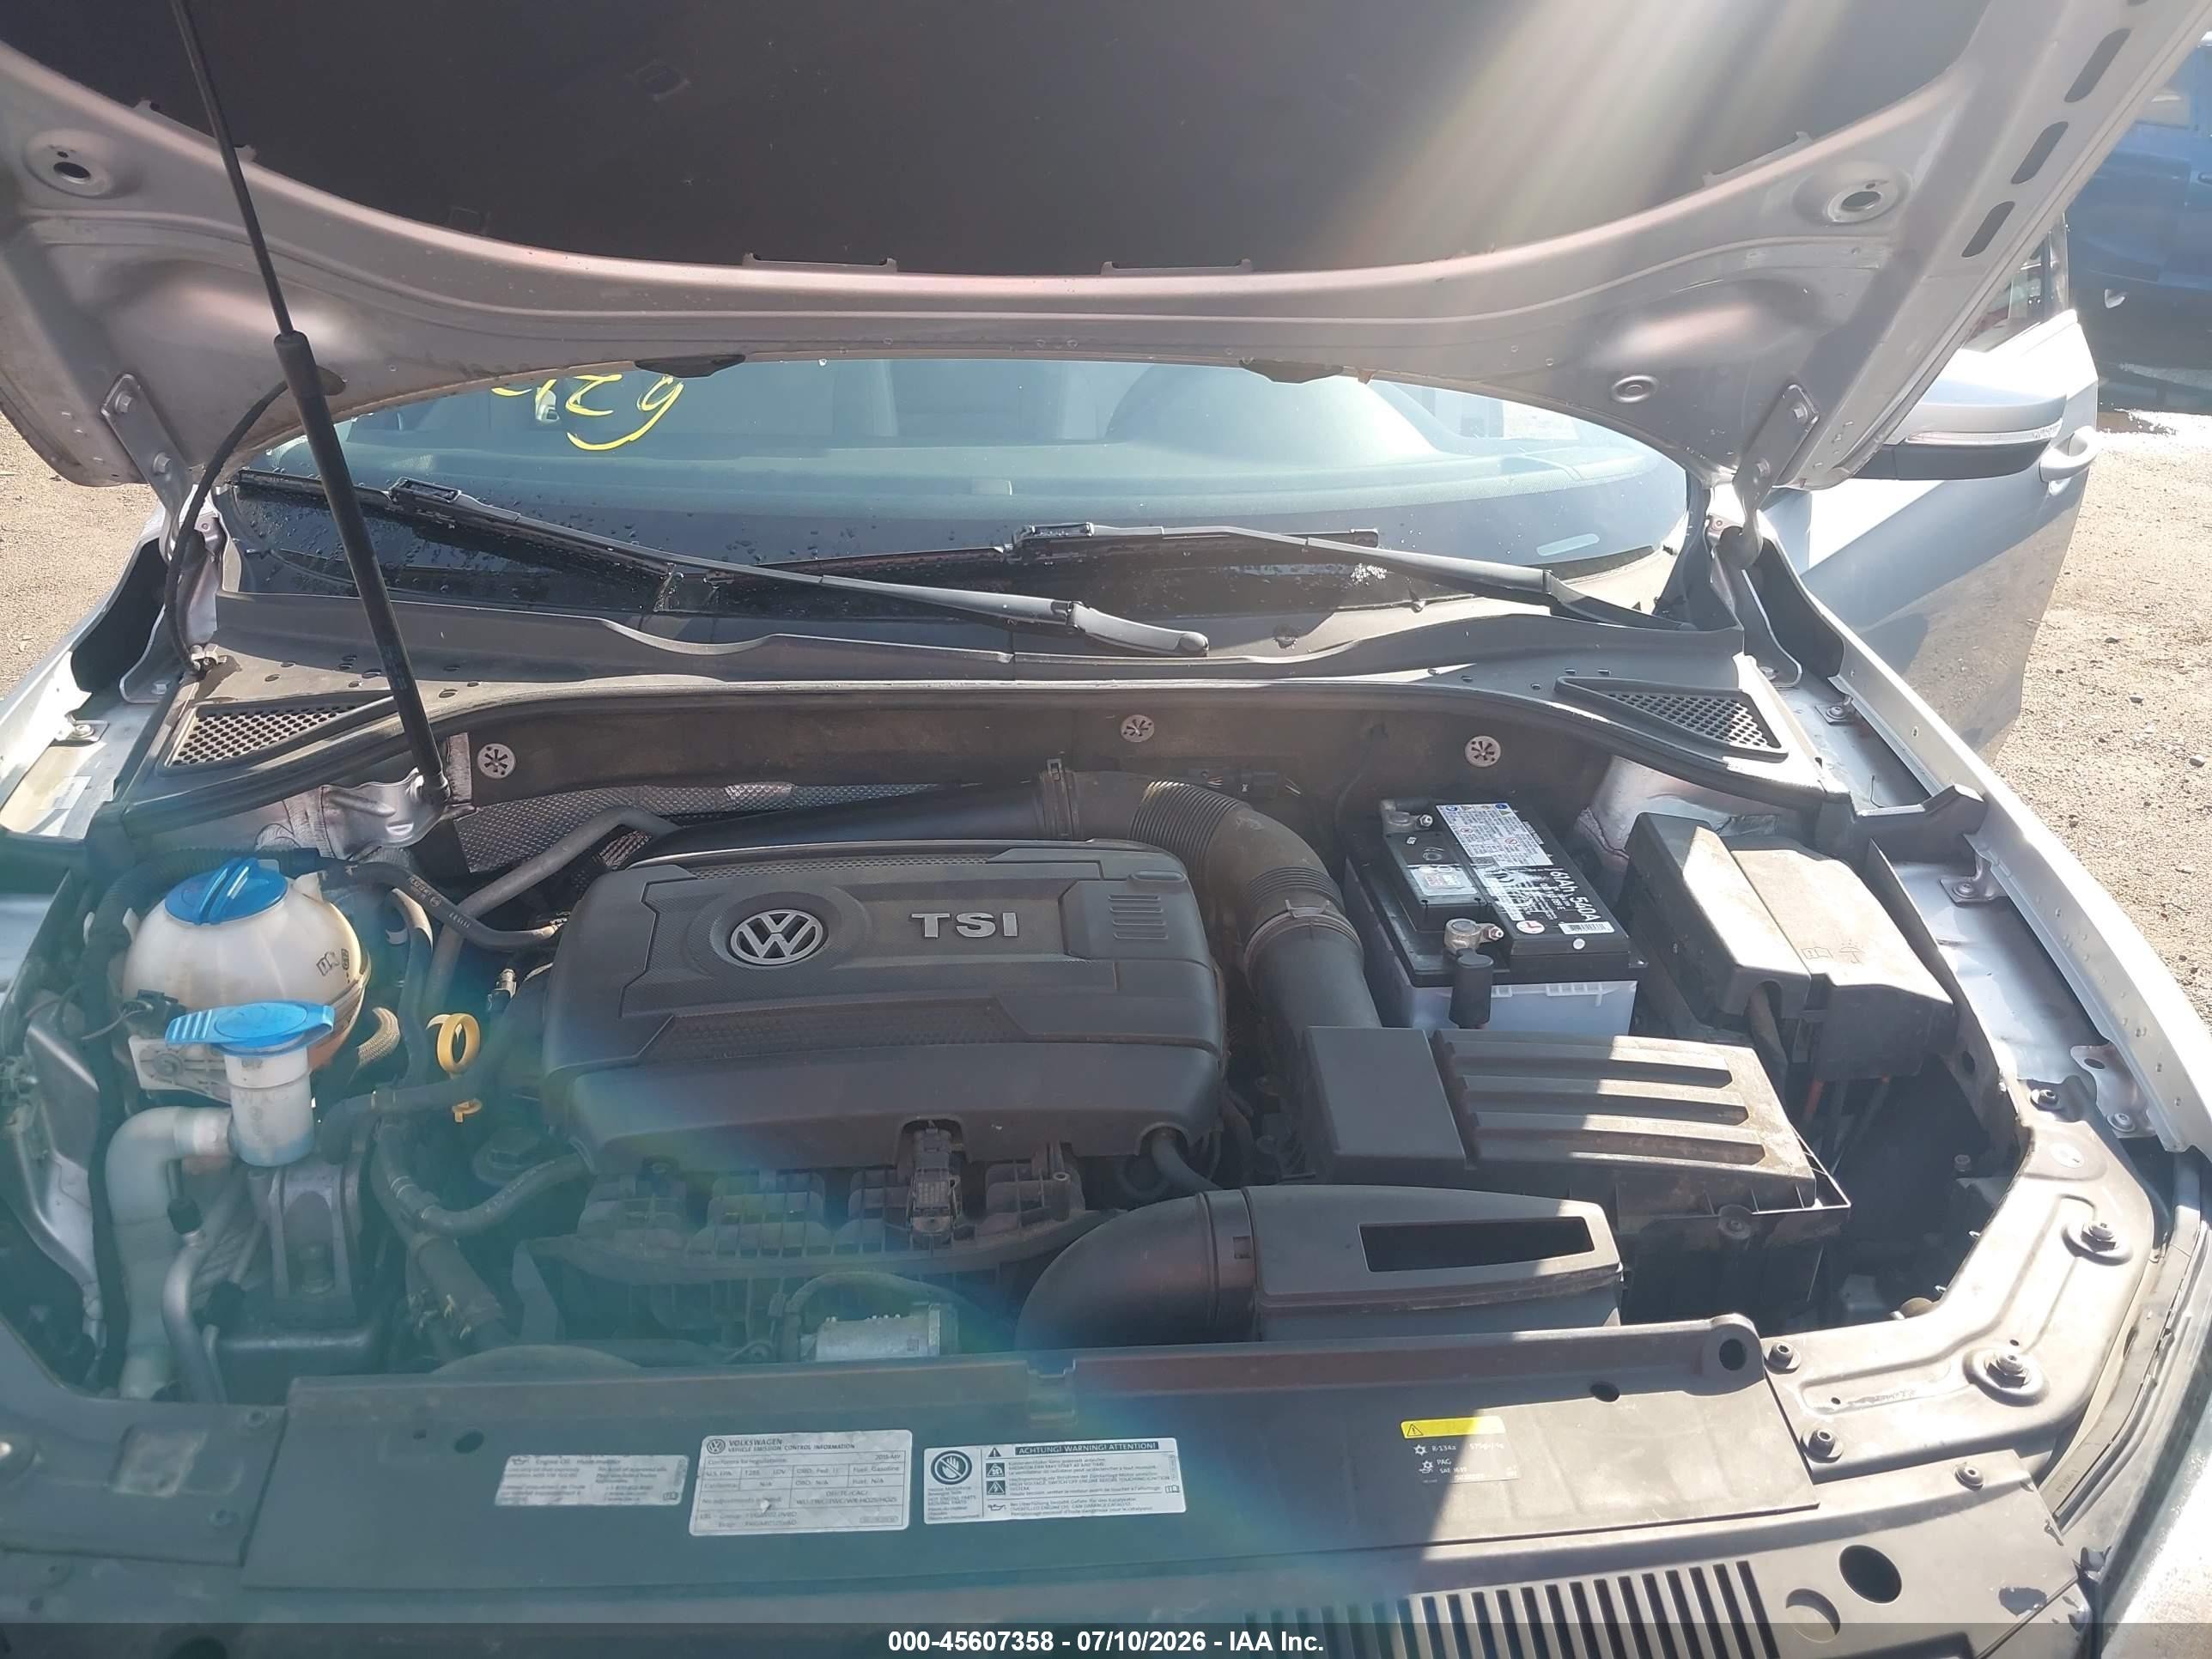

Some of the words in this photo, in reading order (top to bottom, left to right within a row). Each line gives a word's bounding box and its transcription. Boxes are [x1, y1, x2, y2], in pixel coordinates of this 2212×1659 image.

[1550, 871, 1579, 894] 61Ah
[1570, 896, 1601, 921] 540A
[730, 908, 823, 966] VW
[911, 911, 1018, 939] TSI
[728, 1438, 783, 1447] VOLKSWAGEN
[1018, 1445, 1063, 1455] ACHTUNG!
[1064, 1443, 1108, 1453] WARNING!
[1109, 1441, 1157, 1450] ATTENTION!
